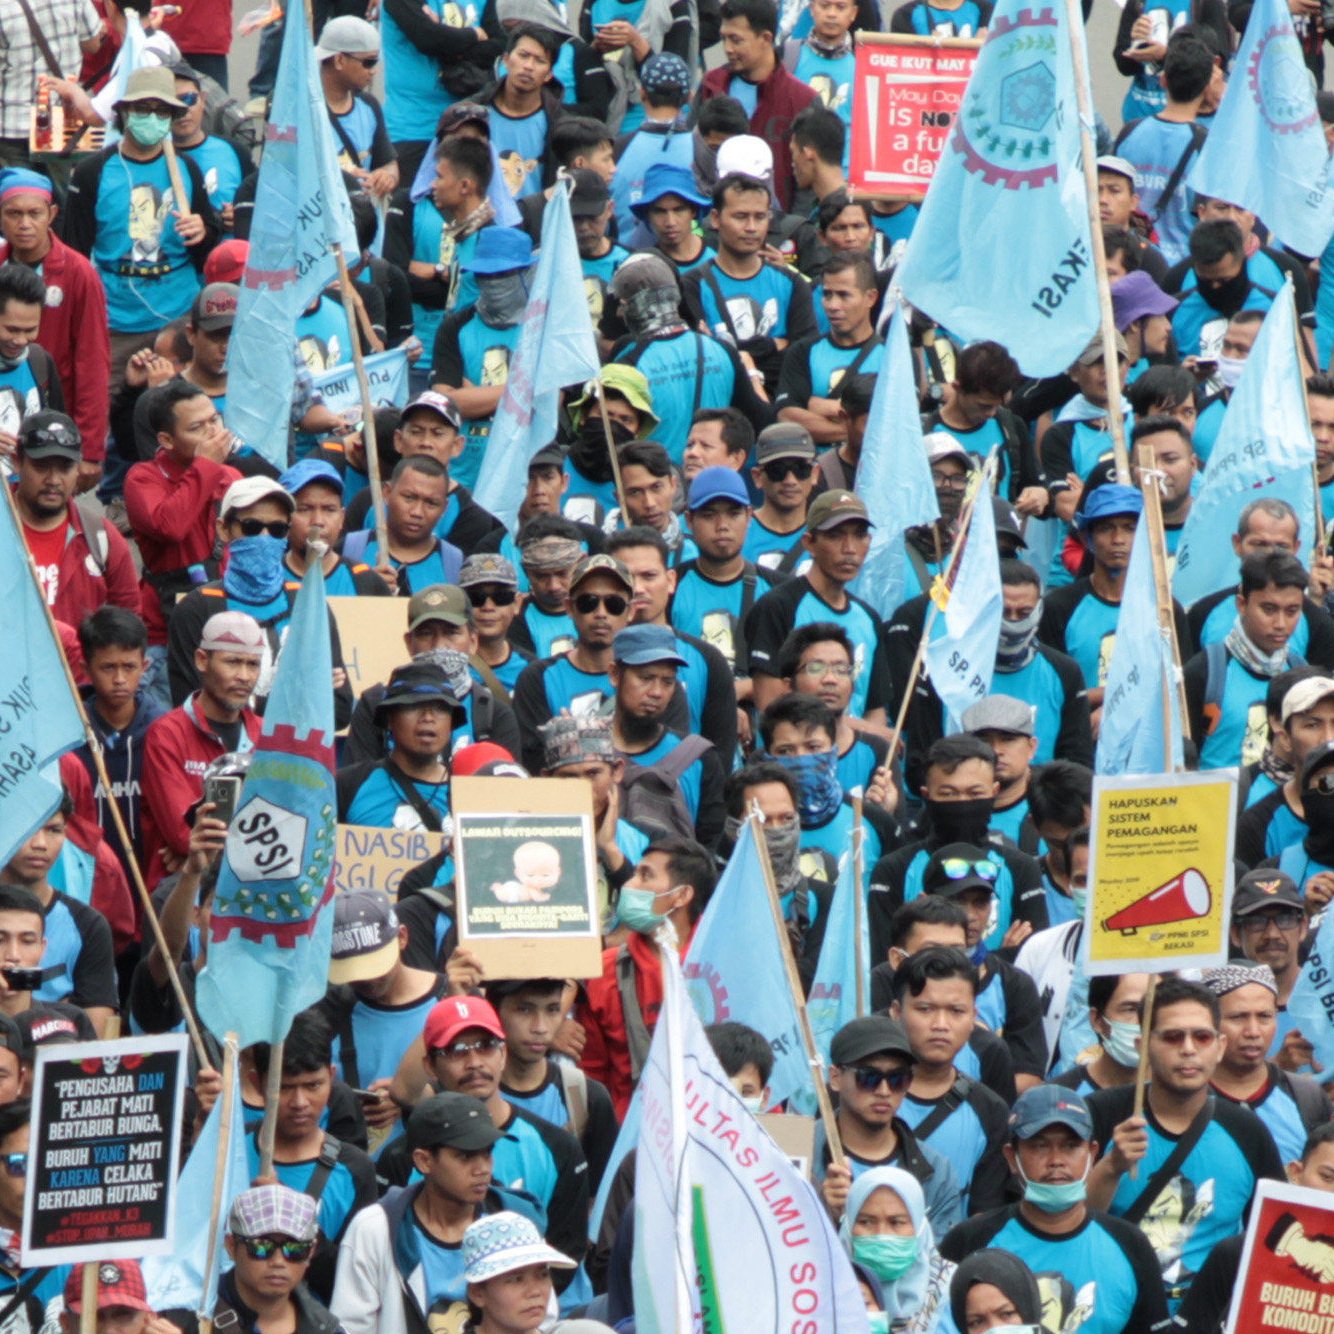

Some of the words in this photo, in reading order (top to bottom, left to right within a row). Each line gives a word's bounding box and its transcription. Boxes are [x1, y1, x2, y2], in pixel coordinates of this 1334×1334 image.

[870, 54, 898, 67] GUE
[901, 56, 933, 69] IKUT
[936, 58, 965, 71] MAY
[889, 88, 927, 105] May
[889, 102, 912, 126] is
[893, 134, 908, 151] a
[1109, 797, 1177, 809] HAPUSKAN
[1109, 812, 1150, 824] SISTEM
[1107, 824, 1197, 838] PEMAGANGAN
[237, 811, 294, 876] SPSI
[345, 830, 430, 861] NASIB
[1164, 941, 1194, 950] BEKASI
[138, 1072, 164, 1091] DAN
[61, 1098, 117, 1119] PEJABAT
[121, 1094, 153, 1114] MATI
[48, 1119, 113, 1141] BERTABUR
[45, 1148, 89, 1168] BURUH
[94, 1145, 126, 1163] YANG
[128, 1141, 162, 1161] MATI
[50, 1169, 99, 1188] KARENA
[104, 1164, 153, 1184] CELAKA
[38, 1190, 102, 1210] BERTABUR
[756, 1169, 810, 1250] ILMU
[1259, 1282, 1316, 1312] BURUH
